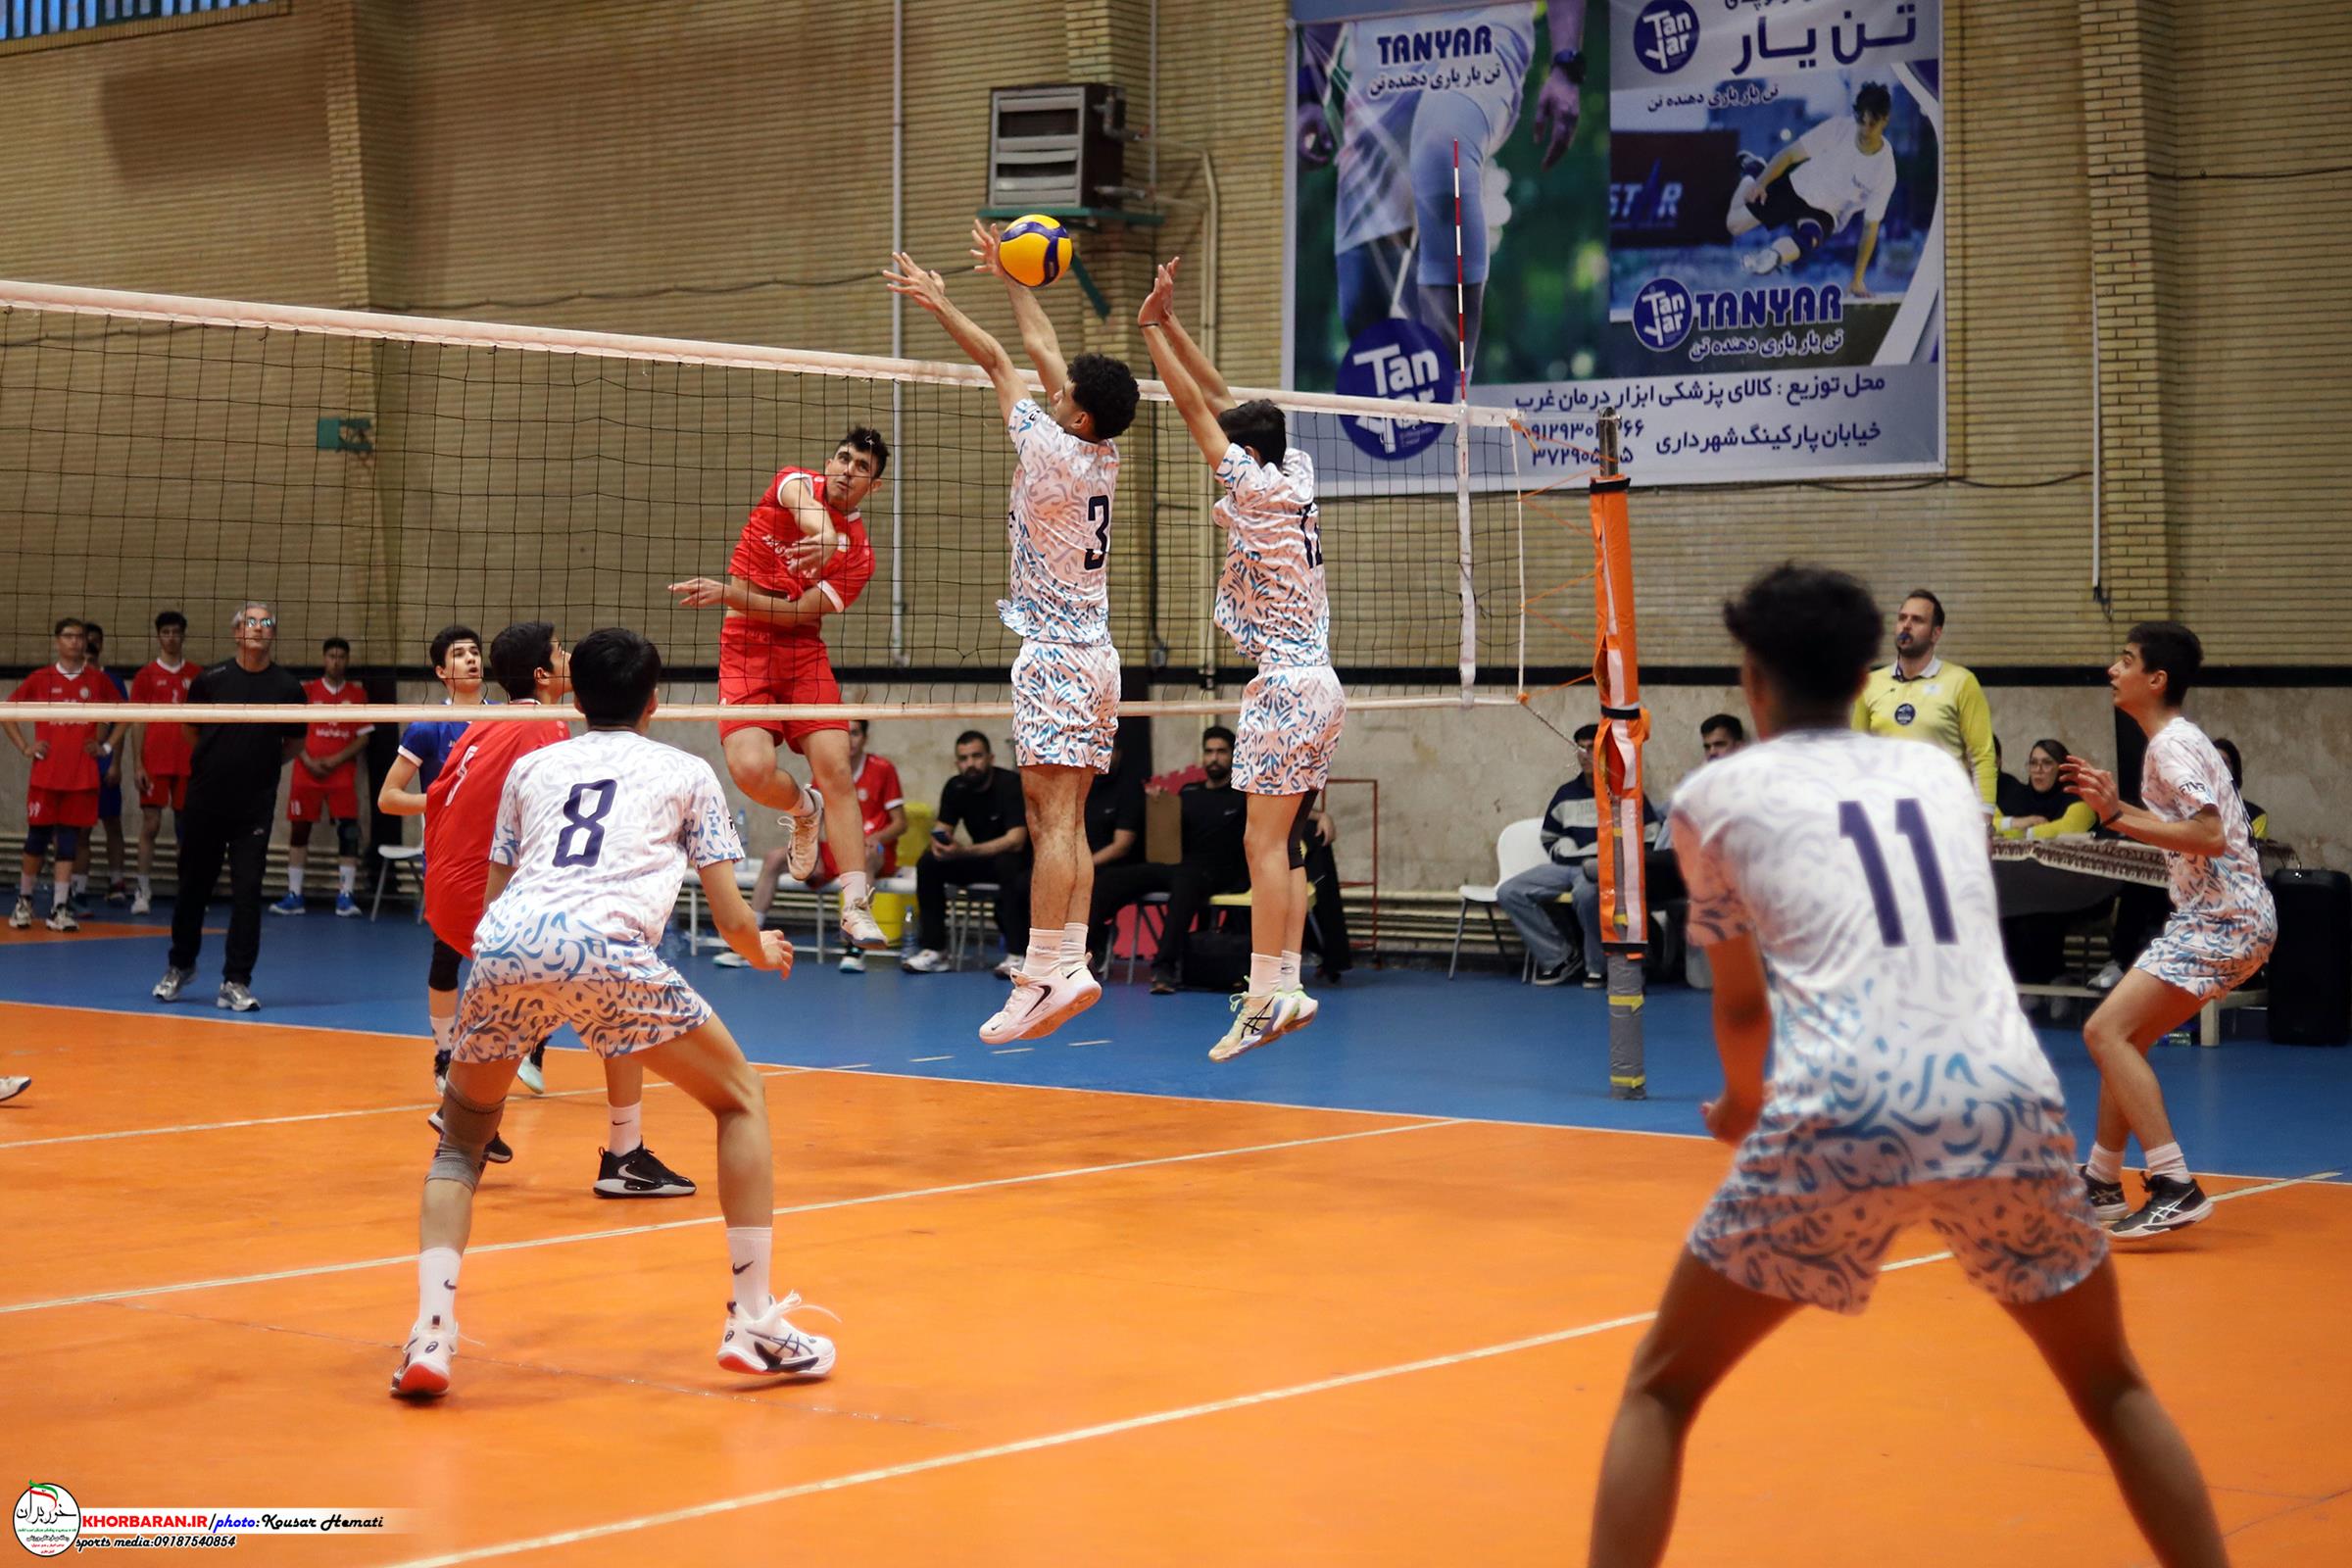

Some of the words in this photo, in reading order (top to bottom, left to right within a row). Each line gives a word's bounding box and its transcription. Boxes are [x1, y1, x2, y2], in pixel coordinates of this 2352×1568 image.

[1642, 10, 1692, 40] Tan
[1832, 5, 1916, 64] تن
[1377, 24, 1492, 65] TANYAR
[1731, 16, 1816, 75] یار
[1388, 74, 1428, 89] دهنده
[1430, 68, 1460, 90] یاری
[1464, 66, 1481, 87] یار
[1484, 63, 1500, 84] تن
[1641, 291, 1686, 316] Tan
[1696, 284, 1842, 330] TANYAR
[1713, 339, 1755, 355] دهنده
[1761, 333, 1796, 358] یاری
[1800, 332, 1819, 356] یار
[1823, 330, 1843, 352] تن
[1352, 343, 1440, 396] Tan
[1615, 385, 1654, 408] ابزار
[1658, 380, 1724, 409] پزشکی
[1728, 377, 1772, 403] کالای
[1787, 376, 1839, 406] توزیع
[1843, 372, 1886, 398] محل
[1515, 389, 1555, 412] غرب
[1558, 388, 1610, 412] درمان
[1656, 427, 1739, 455] شهرداری
[1741, 423, 1819, 453] پارکینگ
[1822, 421, 1882, 448] خیابان
[1084, 495, 1109, 570] 3
[552, 778, 617, 868] 8
[1838, 798, 1959, 948] 11
